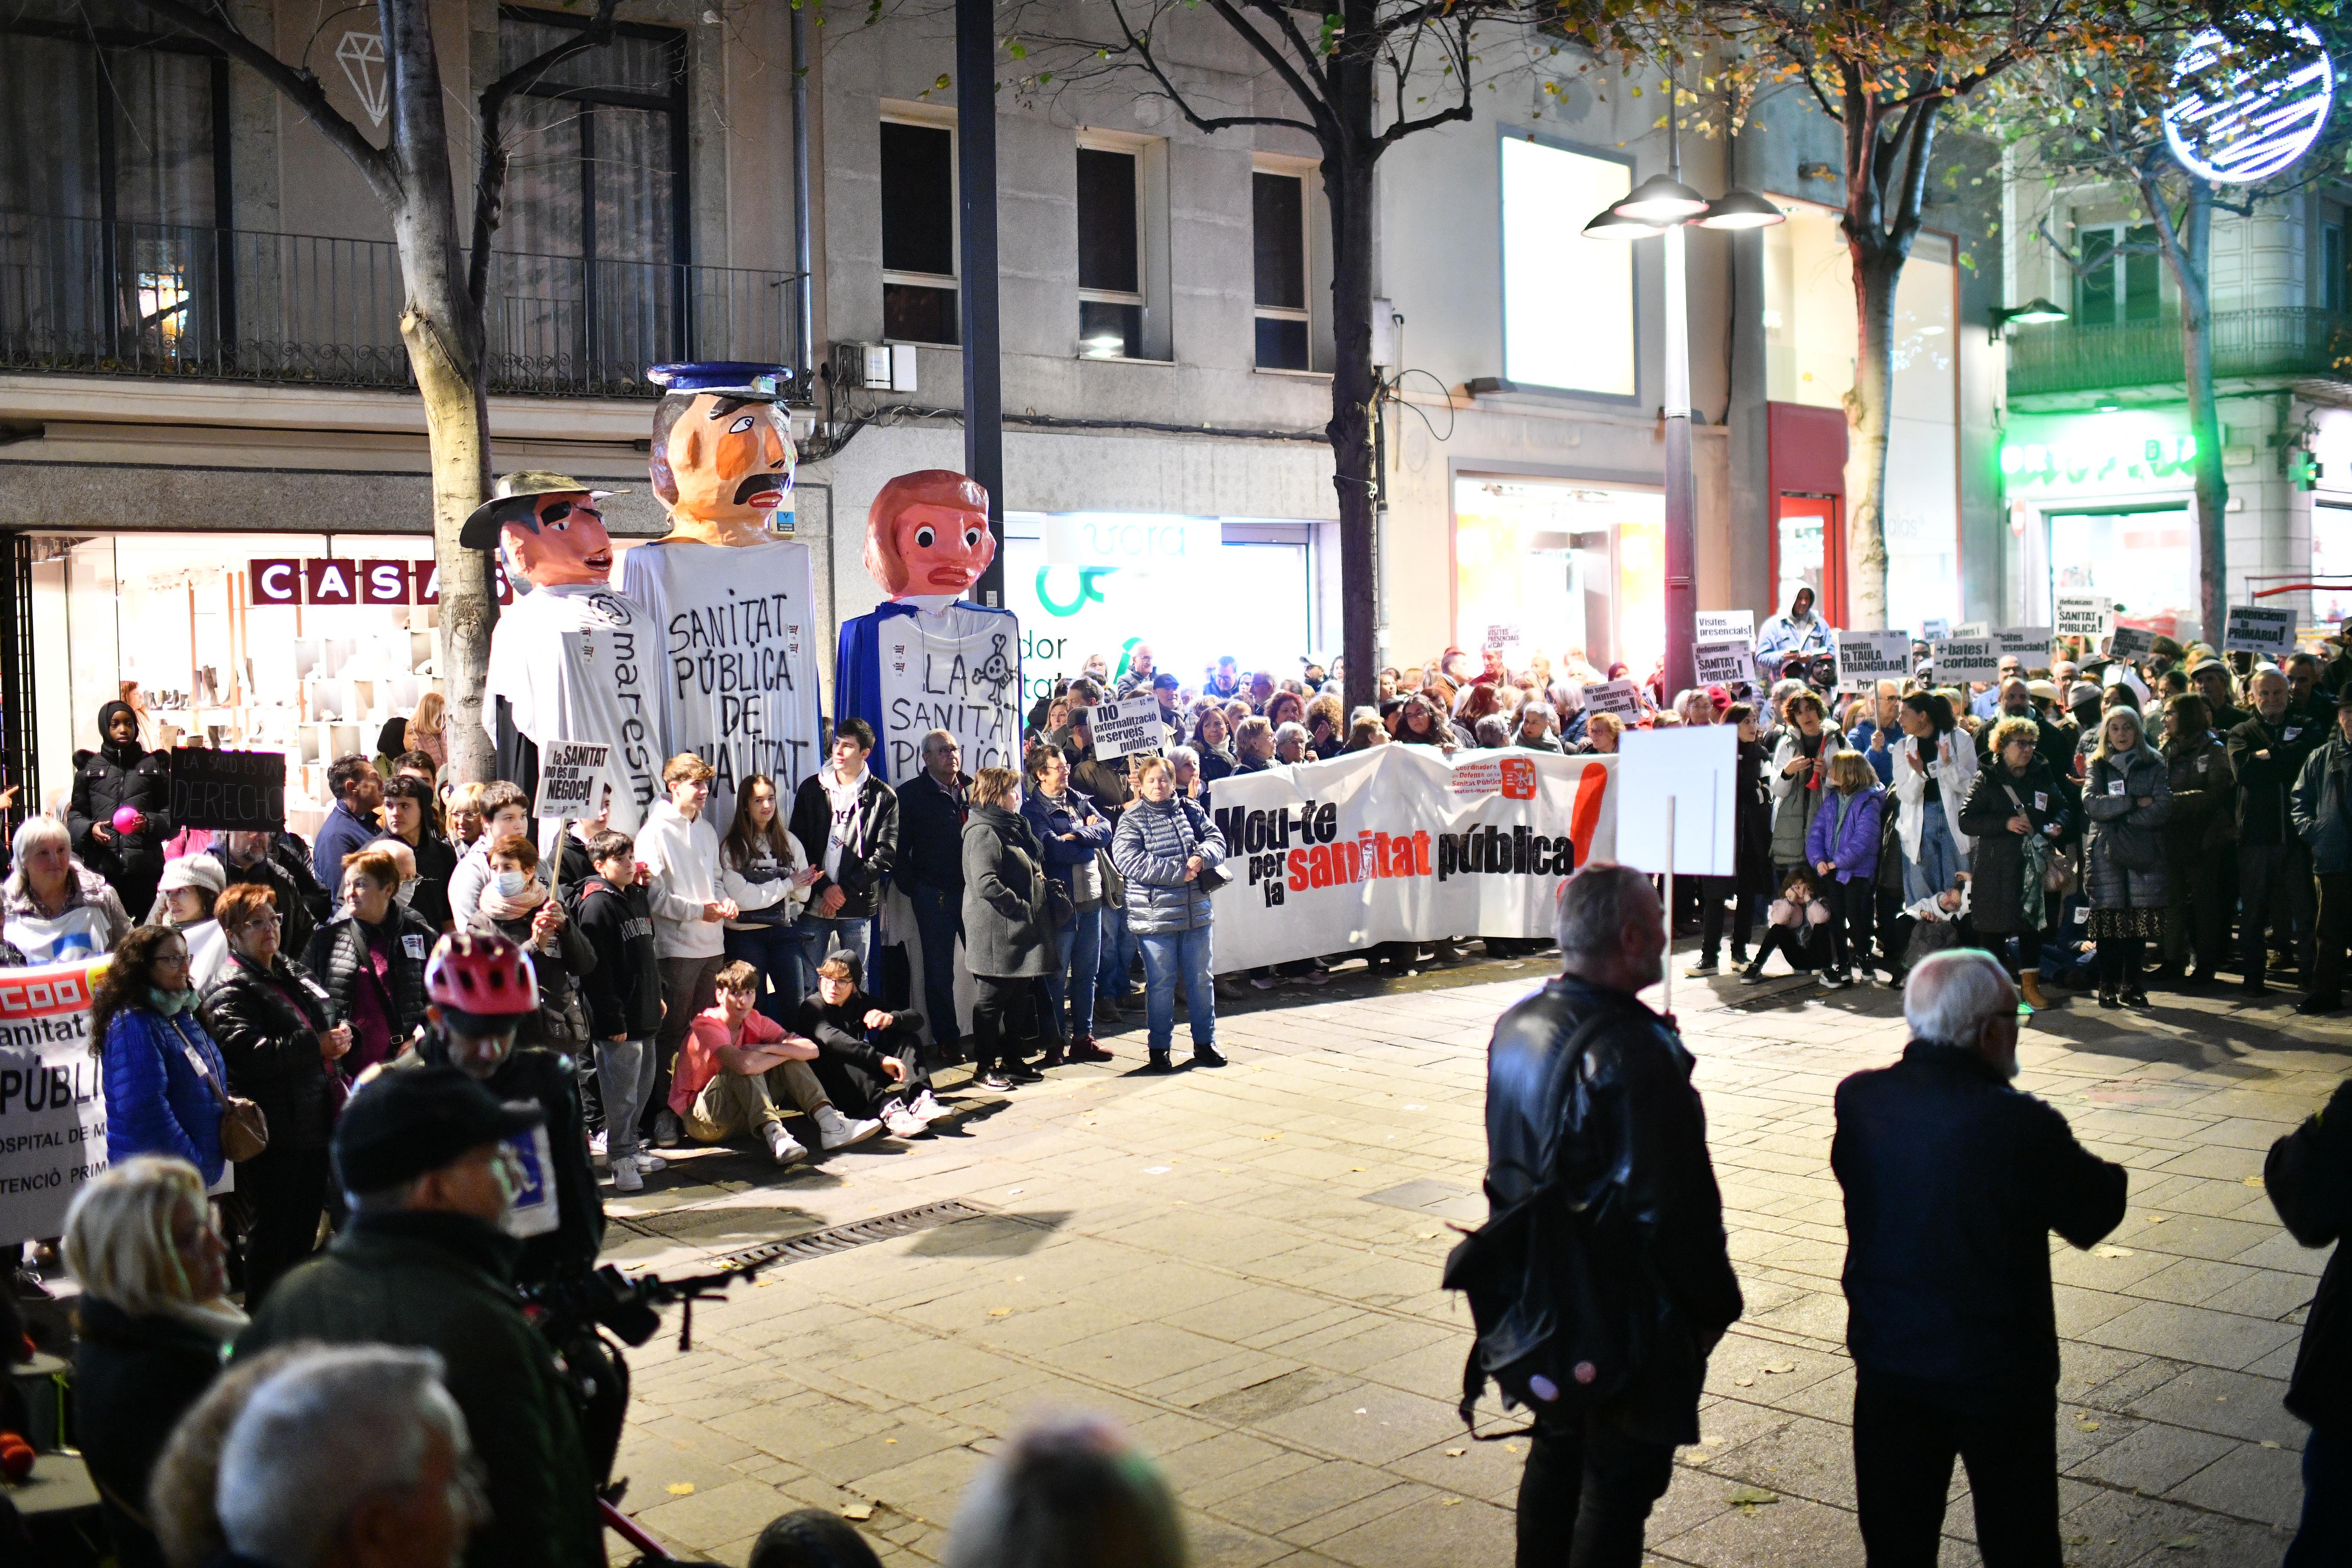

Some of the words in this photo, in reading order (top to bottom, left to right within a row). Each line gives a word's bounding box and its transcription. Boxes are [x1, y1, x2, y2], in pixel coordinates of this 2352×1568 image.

[261, 564, 505, 598] CAS
[2059, 612, 2096, 620] SANITAT
[1696, 645, 1729, 654] defensem
[1841, 642, 1871, 651] reunim
[1841, 652, 1850, 661] la
[1853, 650, 1882, 661] TAULA
[1698, 657, 1735, 671] SANITAT
[926, 654, 967, 696] LA
[722, 694, 762, 737] DE
[1094, 711, 1157, 733] externalització
[1097, 705, 1119, 722] no
[1096, 735, 1105, 743] de
[1106, 726, 1144, 743] serveis
[1119, 736, 1158, 754] públics
[184, 755, 198, 769] LA
[553, 750, 562, 765] la
[563, 745, 608, 767] SANITAT
[544, 766, 556, 778] no
[557, 763, 567, 778] és
[568, 767, 579, 779] un
[173, 779, 283, 821] DERECHO
[1215, 800, 1337, 858] Mou-te
[1249, 852, 1286, 886] per
[1288, 829, 1432, 891] sanitat
[1264, 879, 1284, 908] la
[69, 1126, 89, 1143] DE
